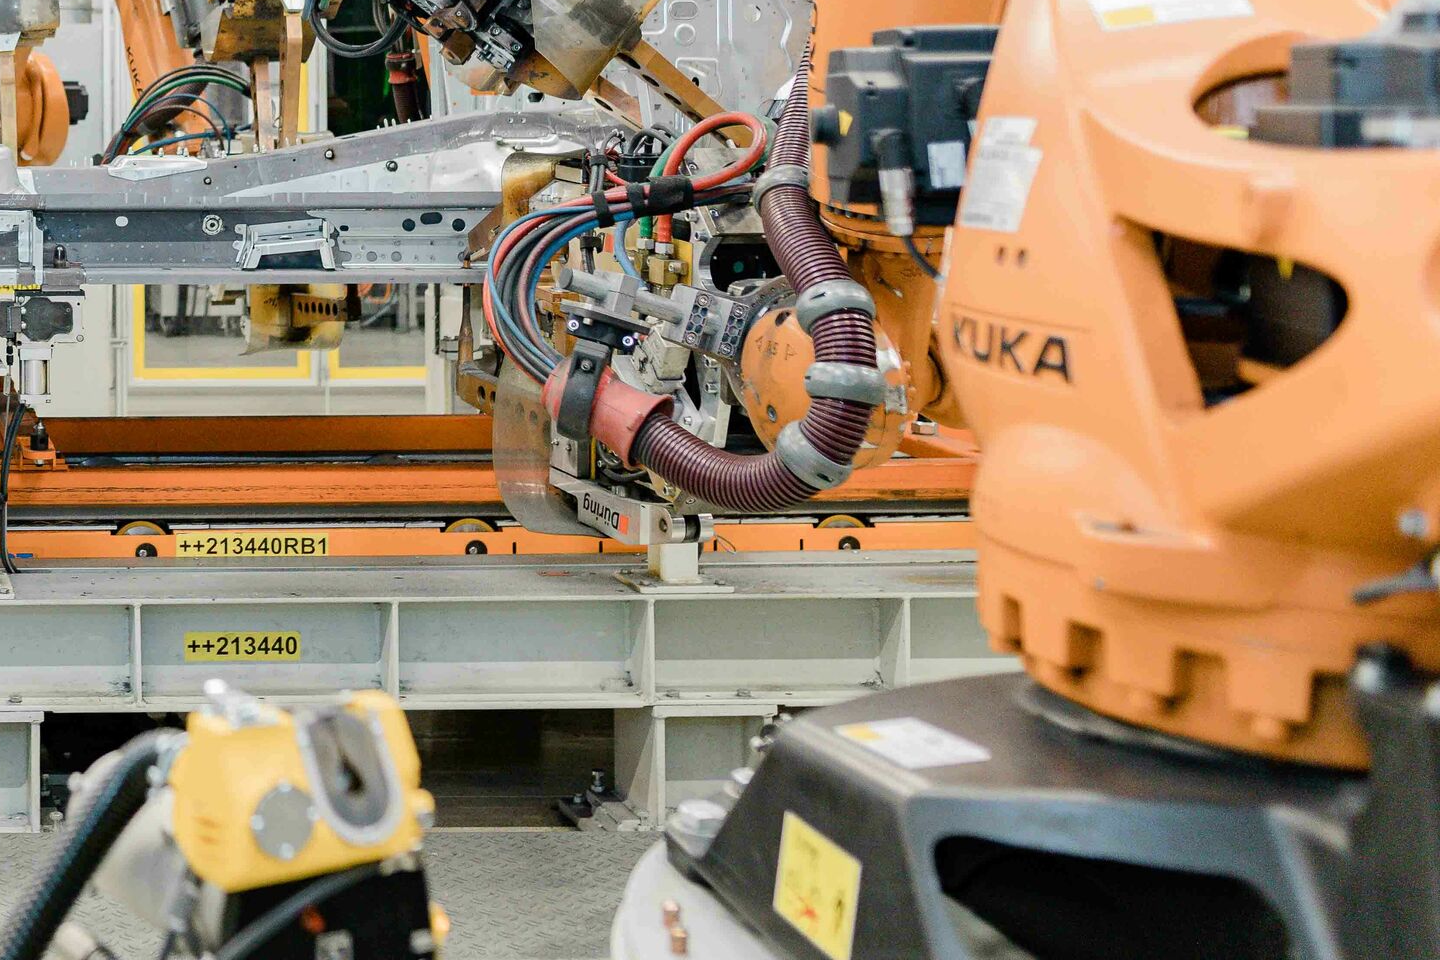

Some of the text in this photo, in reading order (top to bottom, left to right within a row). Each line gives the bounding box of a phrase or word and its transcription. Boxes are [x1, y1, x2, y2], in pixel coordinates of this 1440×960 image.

[950, 313, 1074, 384] KUKA
[583, 492, 620, 530] Düring
[179, 537, 327, 555] ++213440RB1
[187, 636, 298, 656] ++213440
